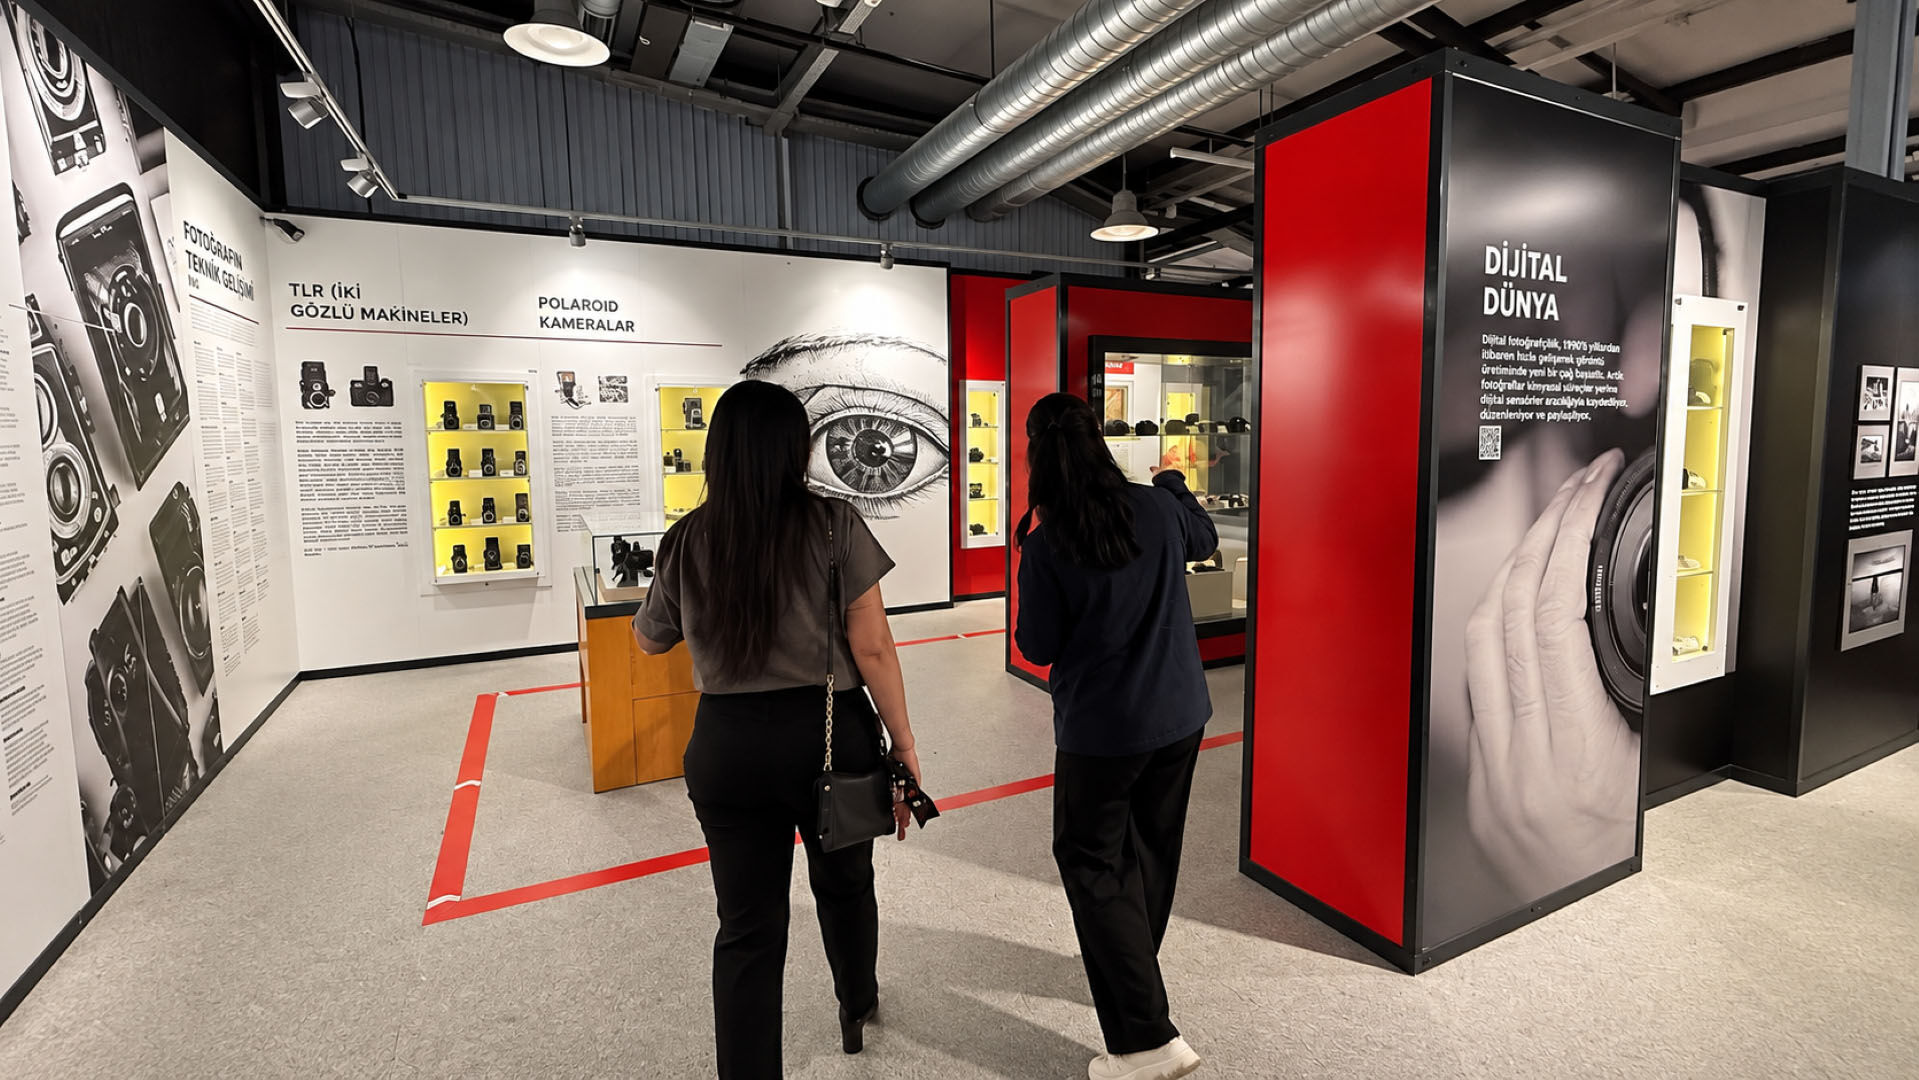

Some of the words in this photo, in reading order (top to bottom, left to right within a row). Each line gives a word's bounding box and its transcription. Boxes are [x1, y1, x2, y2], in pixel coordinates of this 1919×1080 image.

[1484, 240, 1568, 283] DİJİTAL
[185, 249, 221, 284] TEKNİK
[222, 270, 254, 301] GELİŞİMİ
[288, 282, 324, 298] TLR
[331, 281, 361, 300] (İKİ
[538, 296, 619, 313] POLAROID
[1483, 281, 1560, 321] DÜNYA
[290, 302, 354, 320] GÖZLÜ
[361, 305, 468, 326] MAKİNELER)
[539, 315, 635, 333] KAMERALAR
[1482, 334, 1506, 347] Dijital
[1481, 349, 1515, 361] itibaren
[1529, 366, 1546, 379] yeni
[1480, 393, 1505, 407] dijital
[1535, 411, 1546, 420] ve
